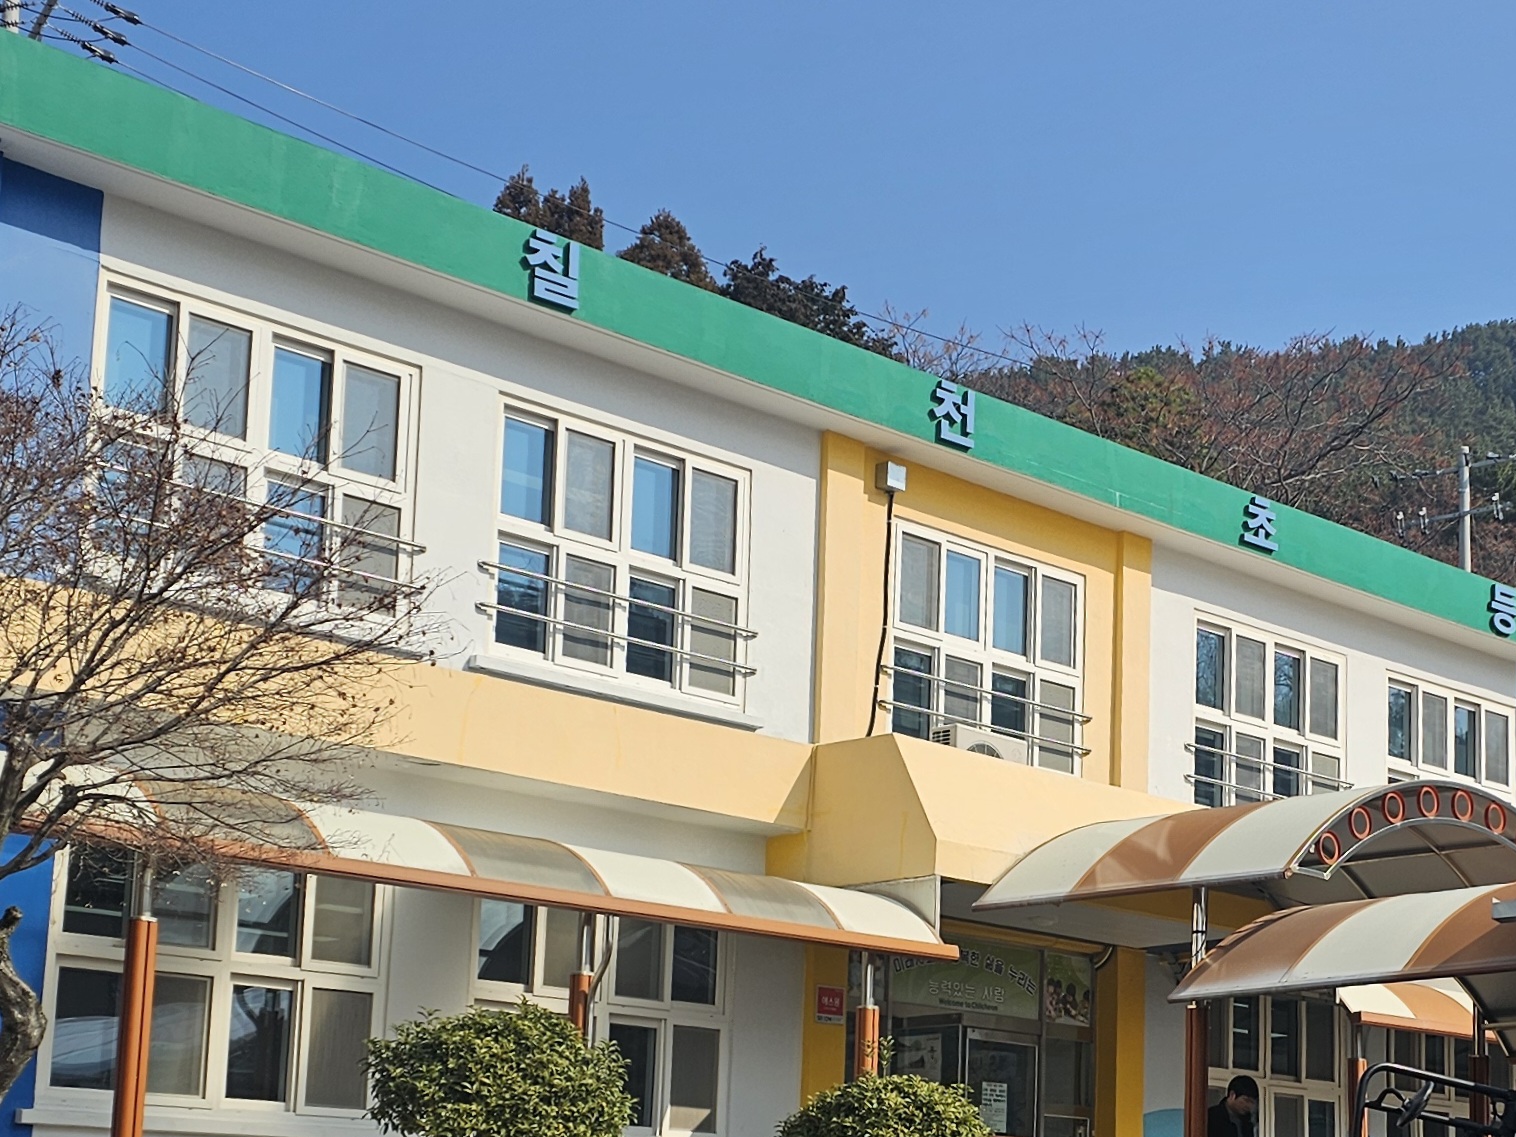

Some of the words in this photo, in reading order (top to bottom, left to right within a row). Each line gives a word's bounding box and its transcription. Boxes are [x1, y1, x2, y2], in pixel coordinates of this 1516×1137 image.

[525, 228, 580, 311] 칠
[931, 380, 975, 452] 천
[1240, 496, 1278, 552] 초
[929, 980, 976, 998] 능력있는
[982, 986, 1005, 1003] 사람
[985, 954, 1005, 976] 삶을
[1008, 965, 1038, 996] 누리는
